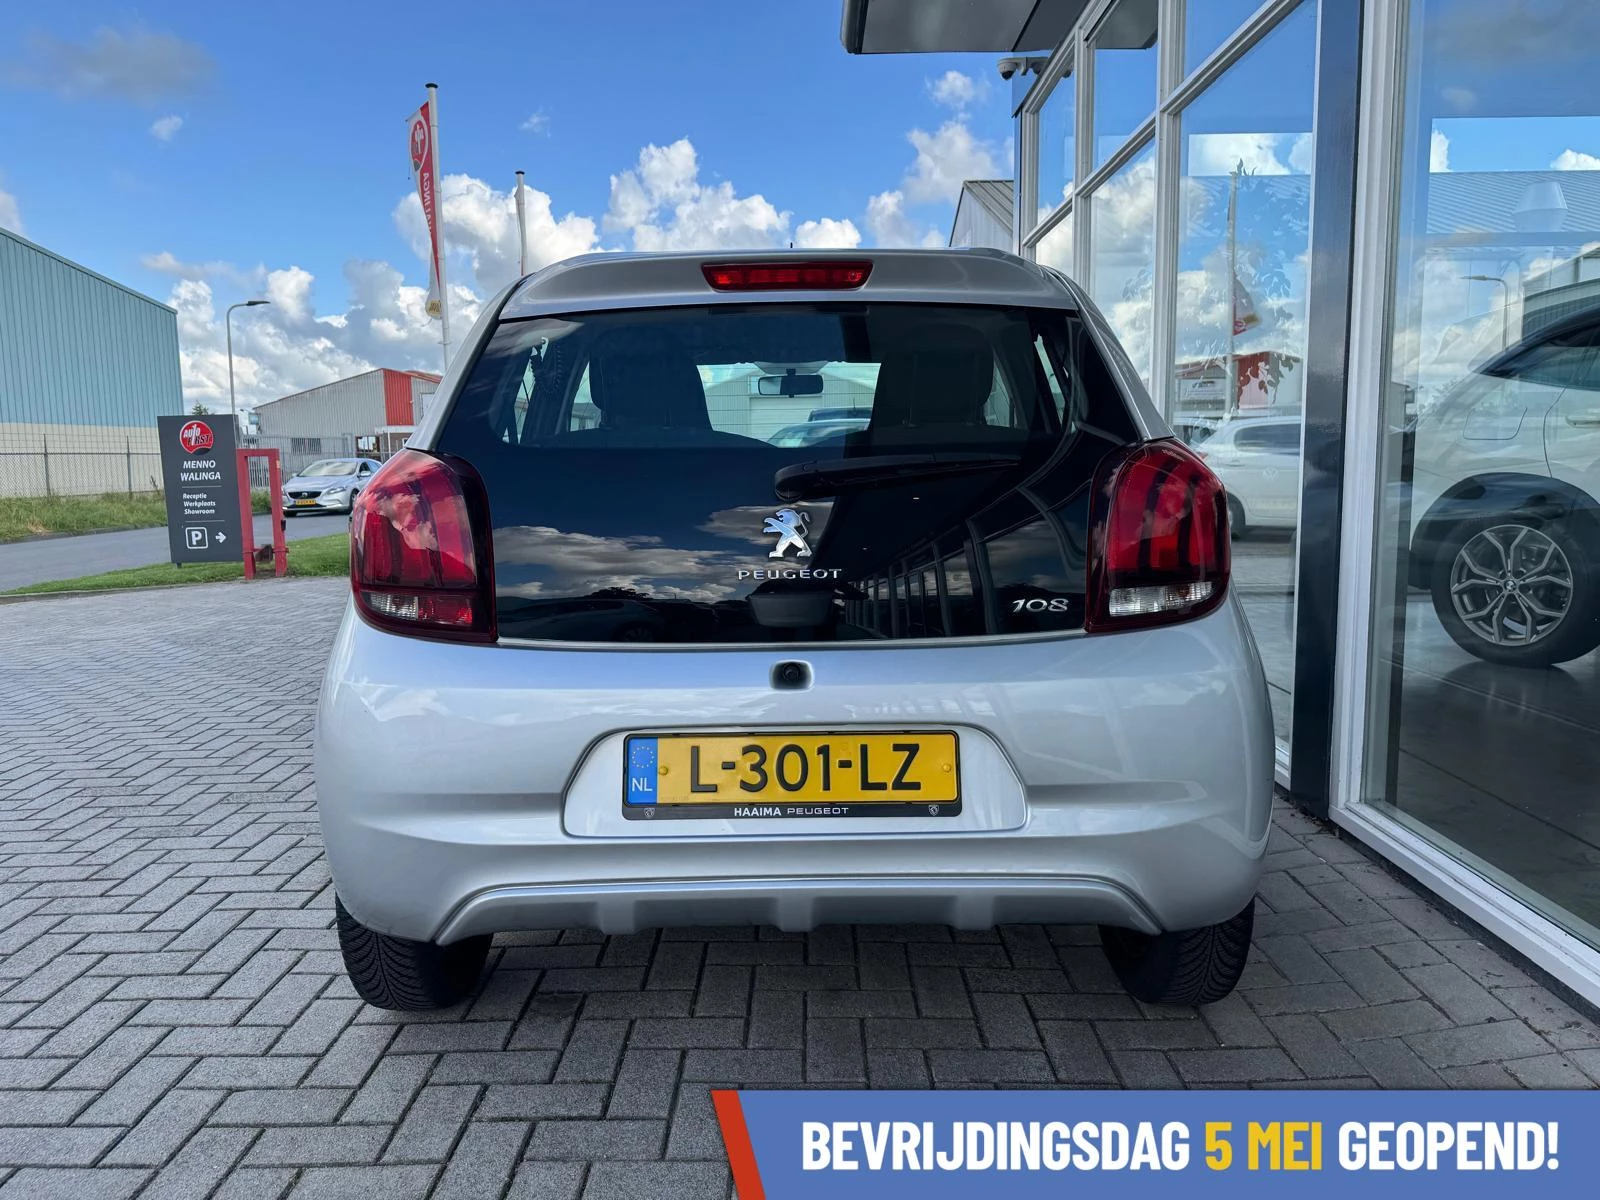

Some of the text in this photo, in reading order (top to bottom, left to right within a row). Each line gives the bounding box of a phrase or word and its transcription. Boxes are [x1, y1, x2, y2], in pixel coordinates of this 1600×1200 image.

[183, 424, 201, 438] AUTO
[183, 460, 216, 469] MENNO
[180, 471, 221, 482] WALINGA
[183, 500, 216, 508] Werkplaats
[191, 530, 202, 546] P
[738, 568, 842, 581] PEUGEOT
[1012, 598, 1069, 613] 108
[632, 743, 922, 793] NL L-301-LZ
[734, 807, 849, 817] HAAIMA PEUGEOT
